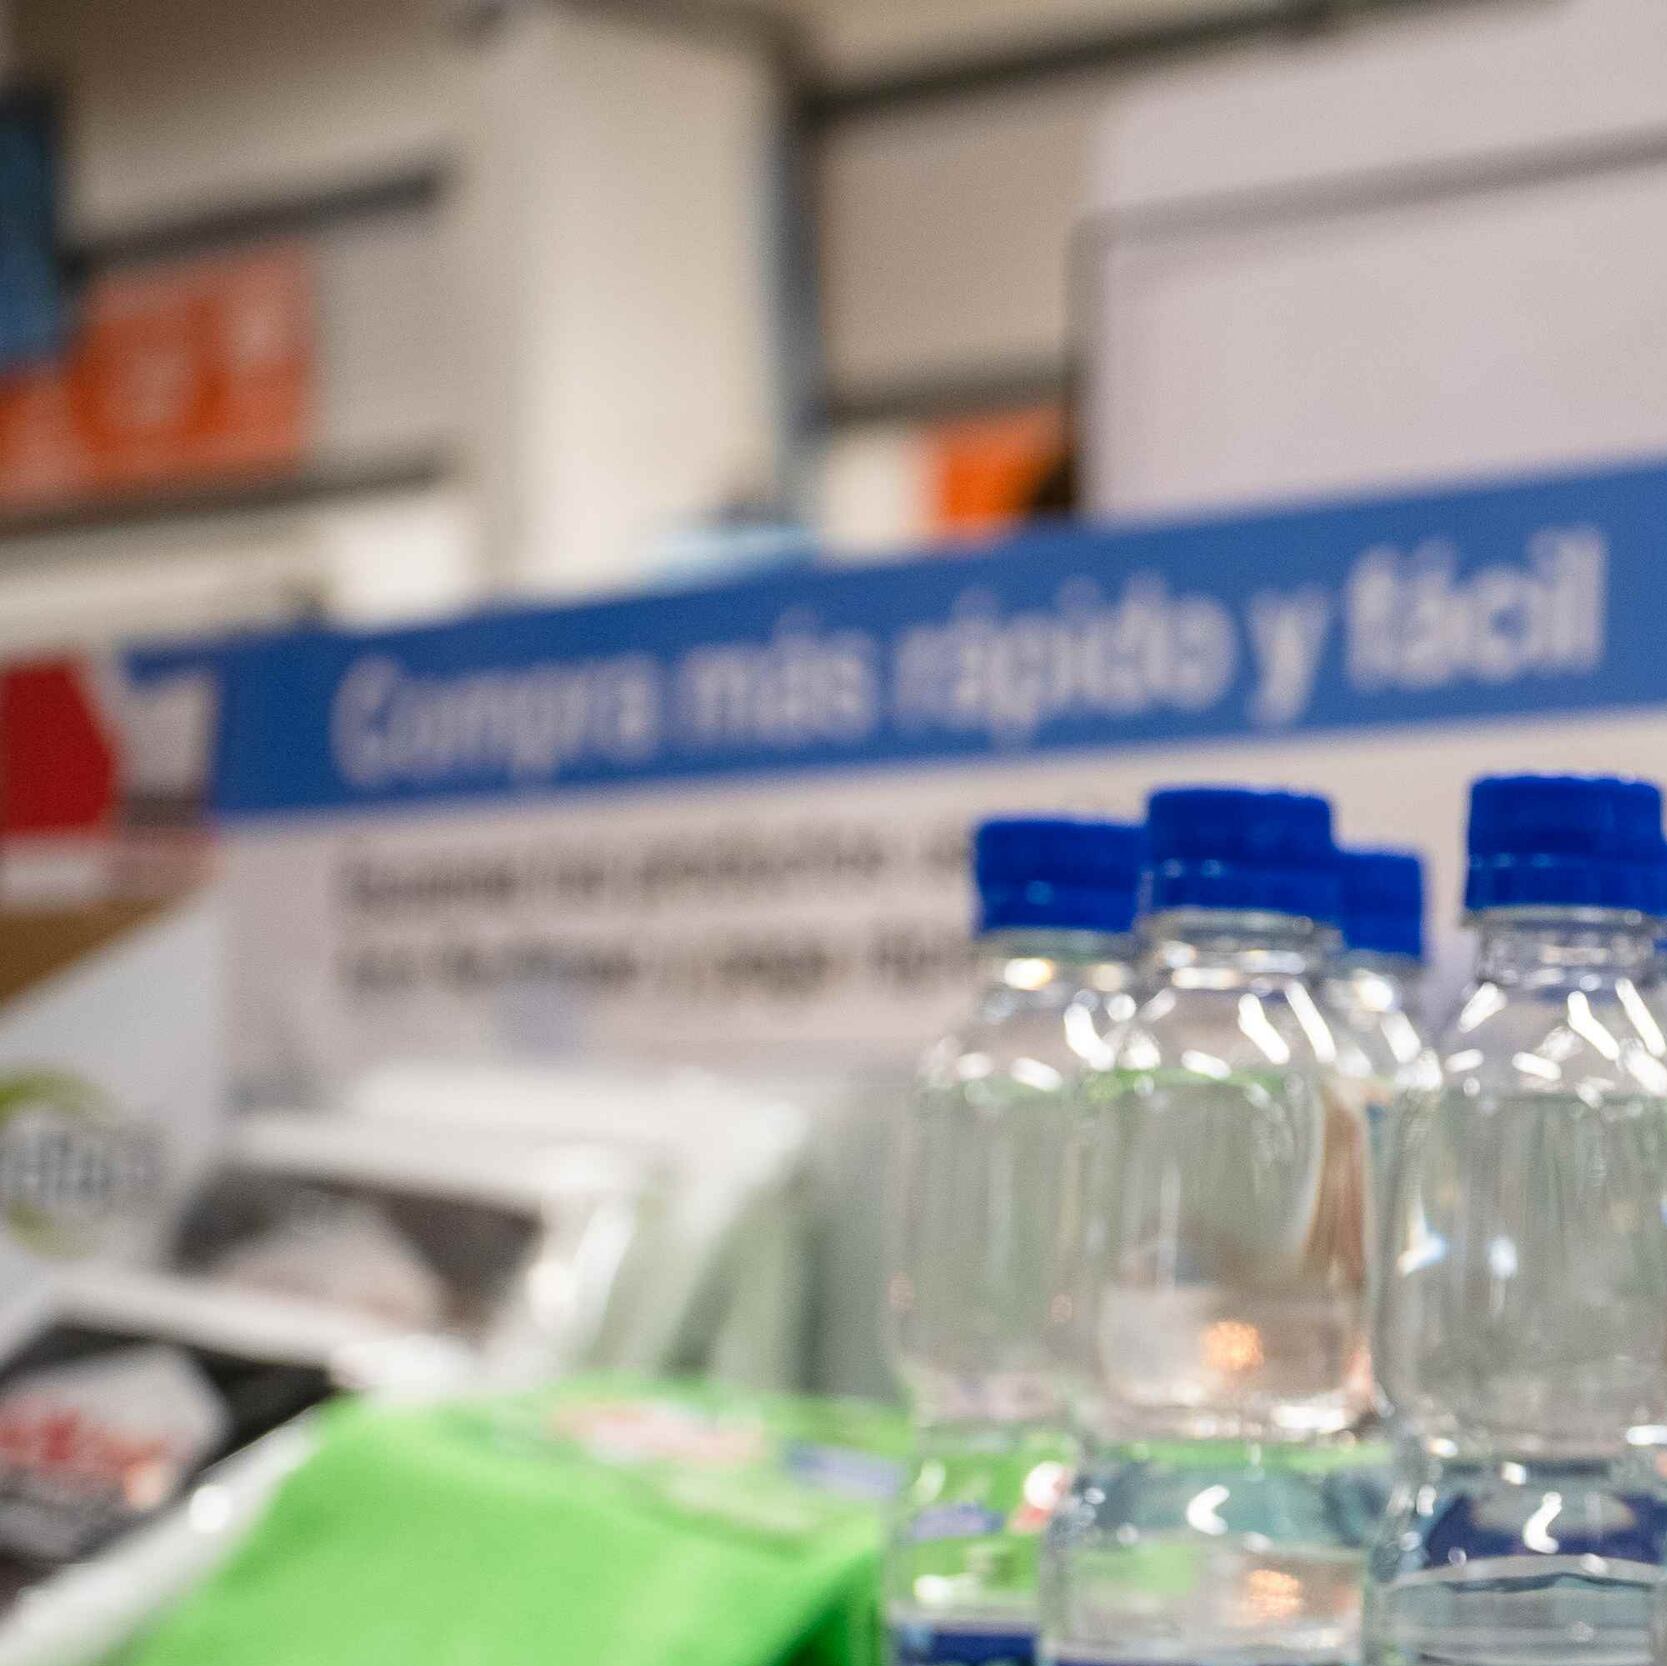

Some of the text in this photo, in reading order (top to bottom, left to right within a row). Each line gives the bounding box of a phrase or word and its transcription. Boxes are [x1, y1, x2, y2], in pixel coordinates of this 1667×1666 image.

[332, 526, 1607, 785] Compra más rápido y fácil
